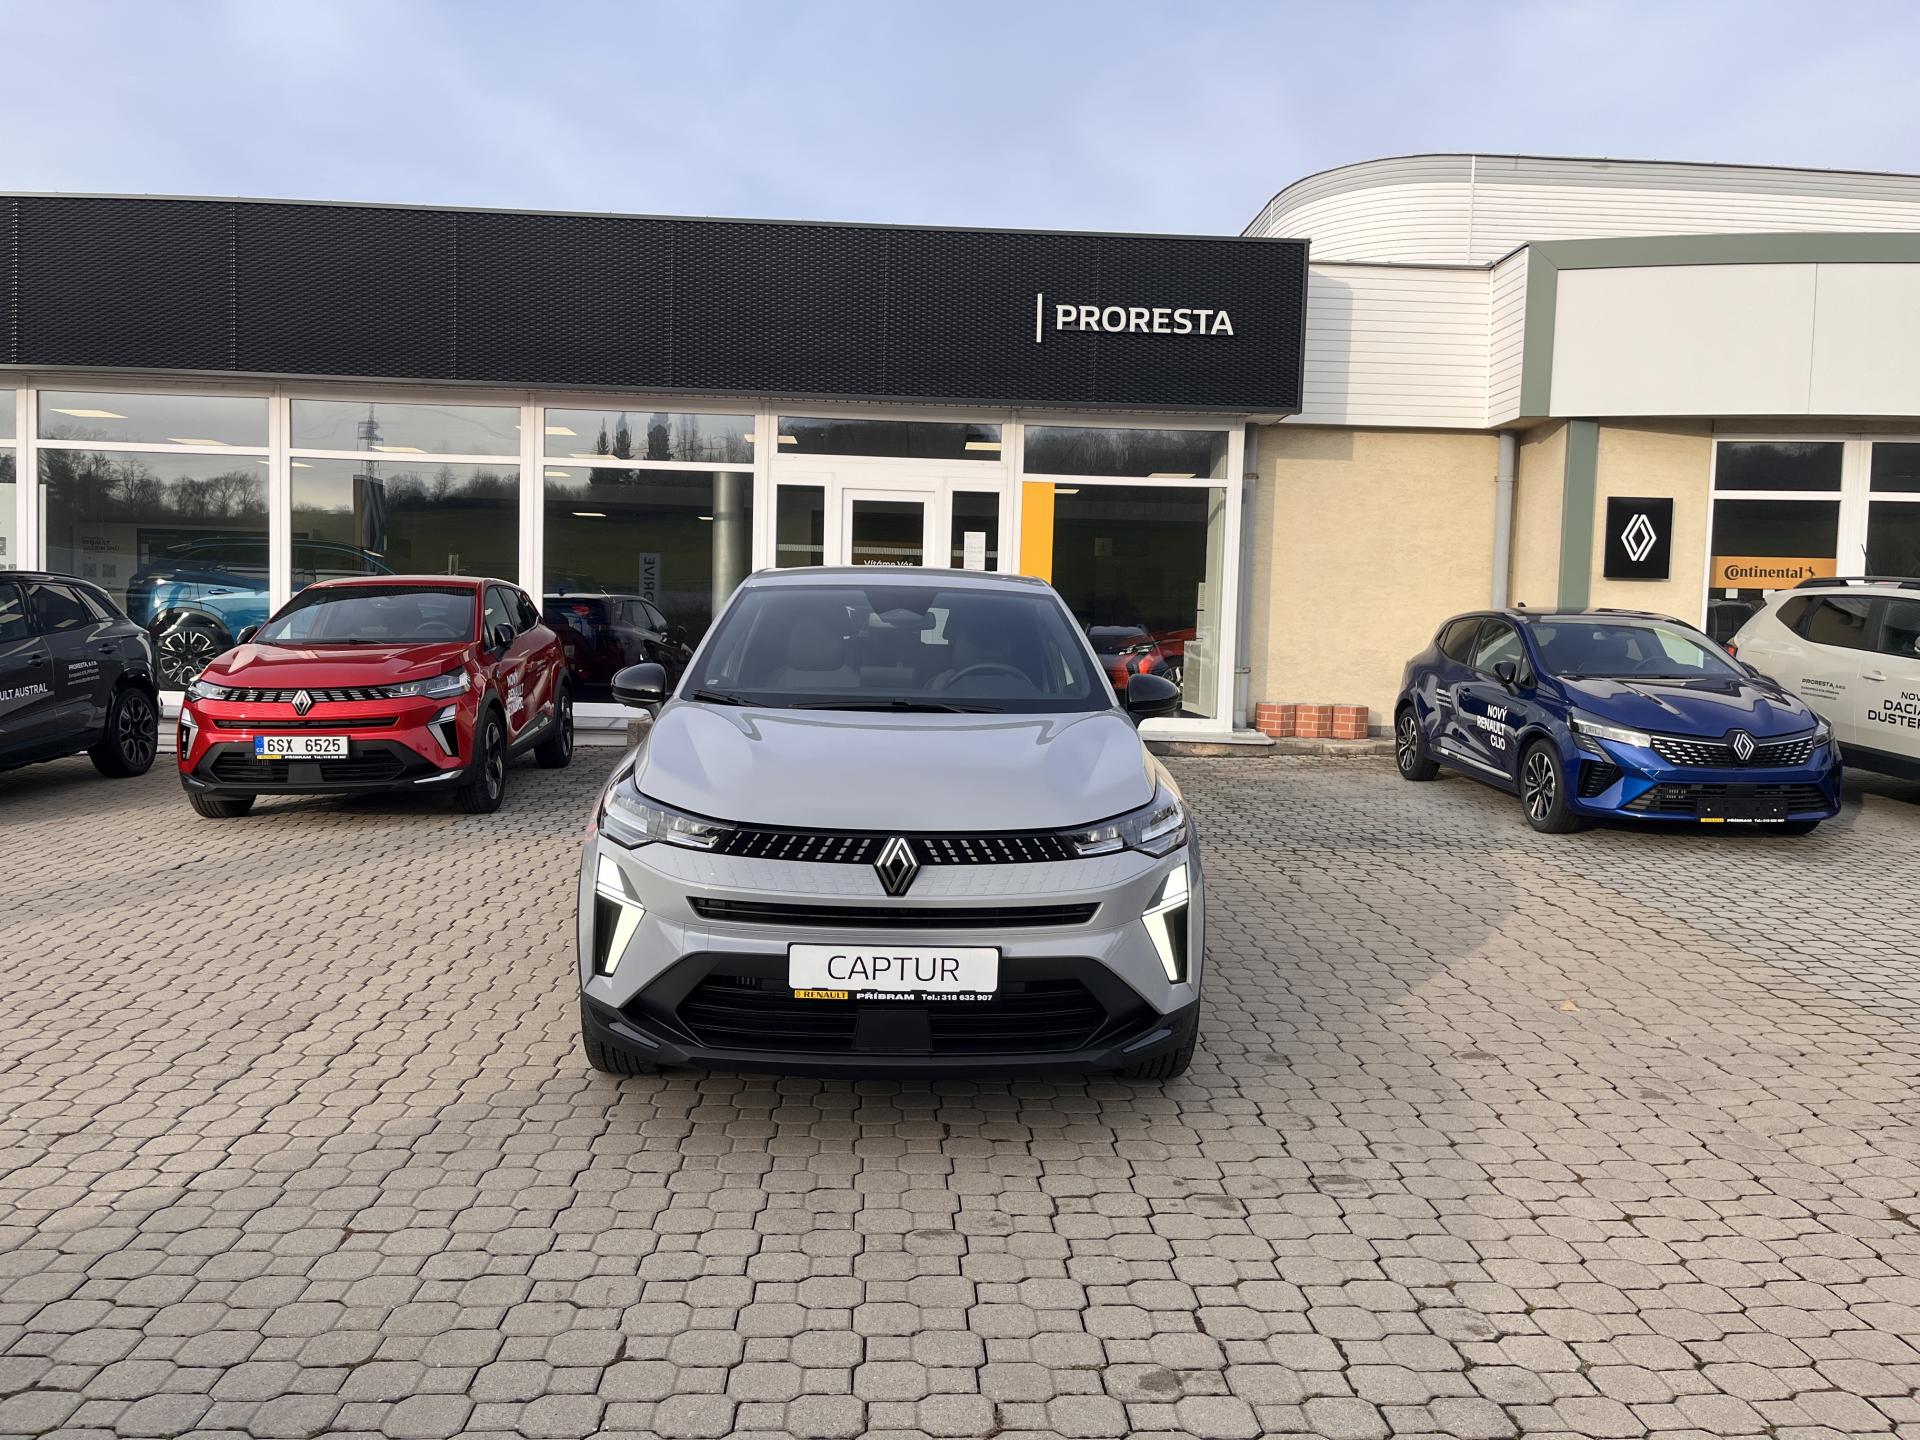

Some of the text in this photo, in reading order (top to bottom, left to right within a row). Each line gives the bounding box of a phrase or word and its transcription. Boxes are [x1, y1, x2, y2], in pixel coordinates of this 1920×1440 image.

[1056, 304, 1234, 336] PRORESTA
[1724, 564, 1803, 580] Continental
[14, 682, 48, 699] AUSTRAL
[1487, 704, 1508, 722] NOVÝ
[1476, 715, 1506, 736] RENAULT
[267, 739, 341, 753] 6SX 6525
[1490, 734, 1506, 751] CLIO
[827, 955, 960, 982] CAPTUR
[803, 991, 846, 999] RENAULT
[856, 992, 915, 1001] PŘÍBRAM
[921, 993, 940, 1001] Tel.:
